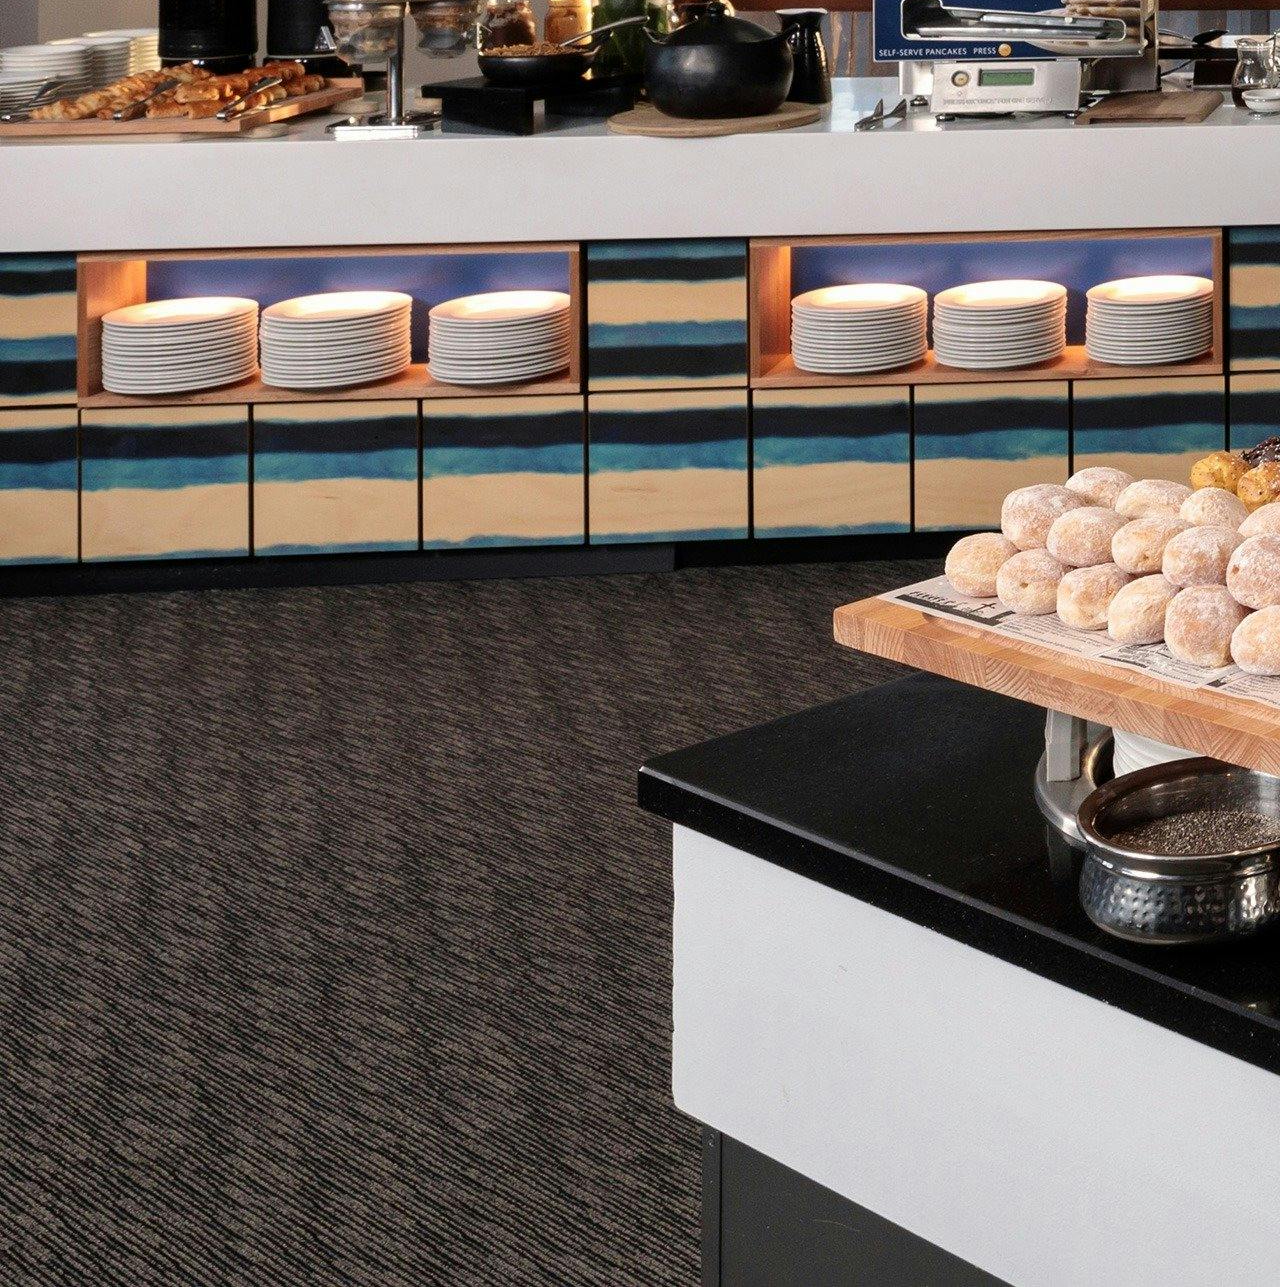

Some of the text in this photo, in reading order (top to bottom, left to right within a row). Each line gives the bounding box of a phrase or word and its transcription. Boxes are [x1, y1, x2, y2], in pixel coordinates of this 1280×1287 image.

[879, 47, 996, 57] SELF-SERVE PANCAKES PRESS
